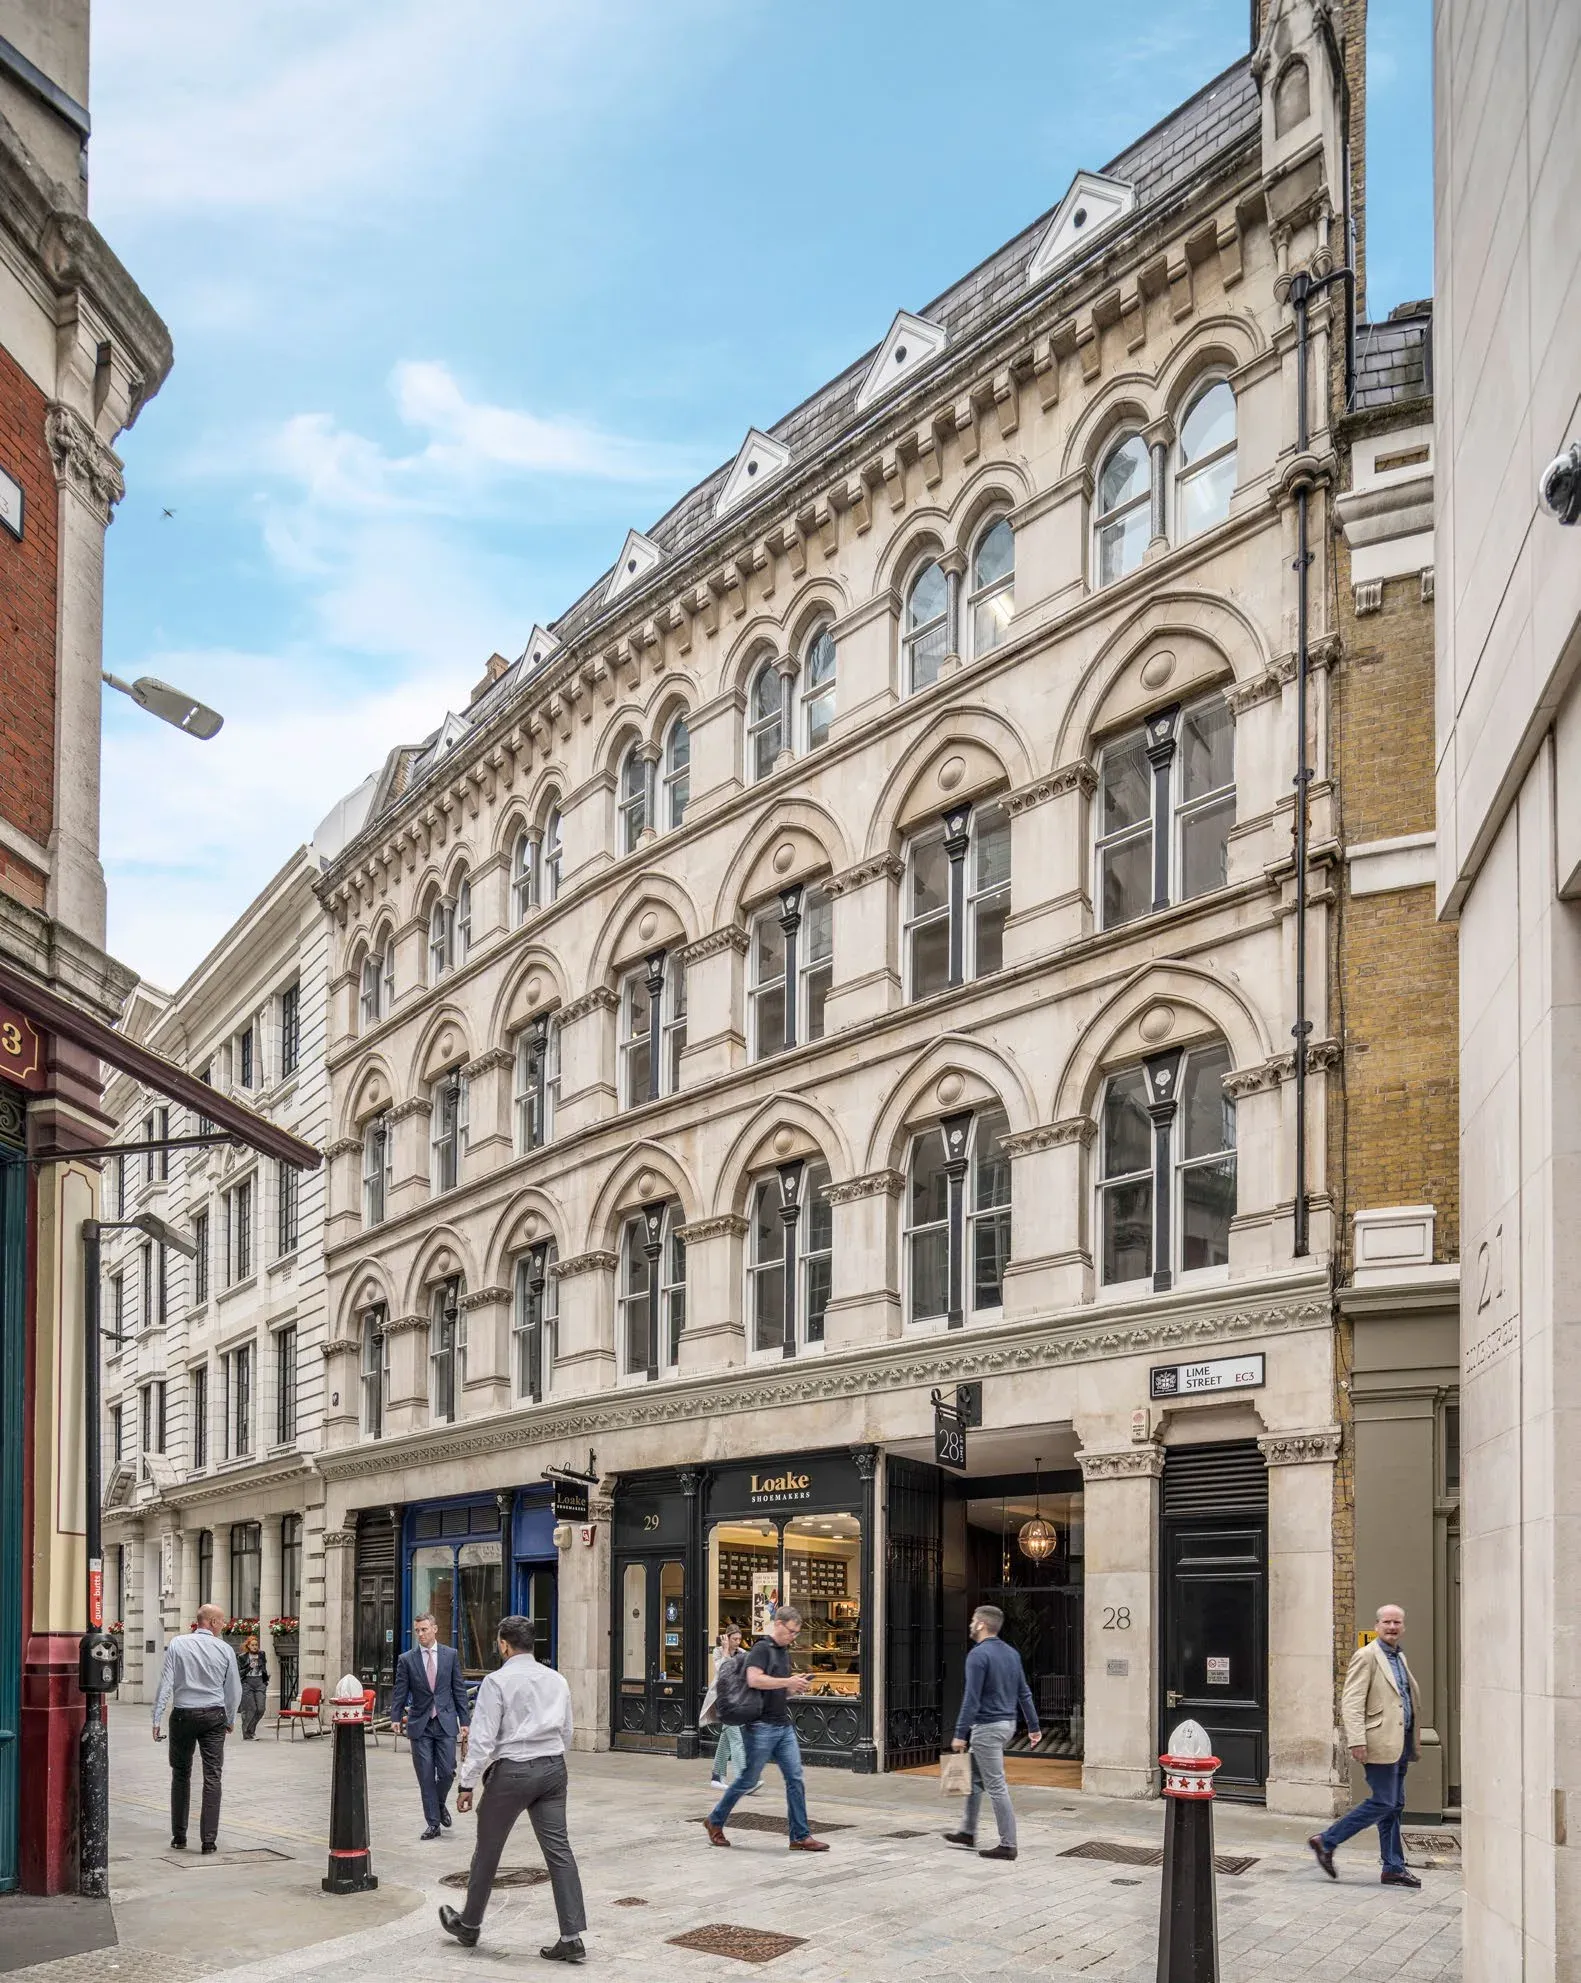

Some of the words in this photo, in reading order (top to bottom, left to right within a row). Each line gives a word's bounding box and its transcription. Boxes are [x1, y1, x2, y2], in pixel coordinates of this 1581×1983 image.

[2, 1023, 22, 1055] 3
[1477, 1223, 1506, 1316] 21
[1186, 1366, 1210, 1378] LIME
[1186, 1376, 1222, 1389] STREET
[1235, 1372, 1255, 1383] EC3
[939, 1428, 959, 1461] 28
[750, 1471, 810, 1493] Loake
[556, 1492, 586, 1506] Loake
[751, 1492, 811, 1503] SHOEMAKERS
[644, 1514, 659, 1530] 29
[93, 1575, 101, 1597] butts
[1102, 1606, 1131, 1630] 28
